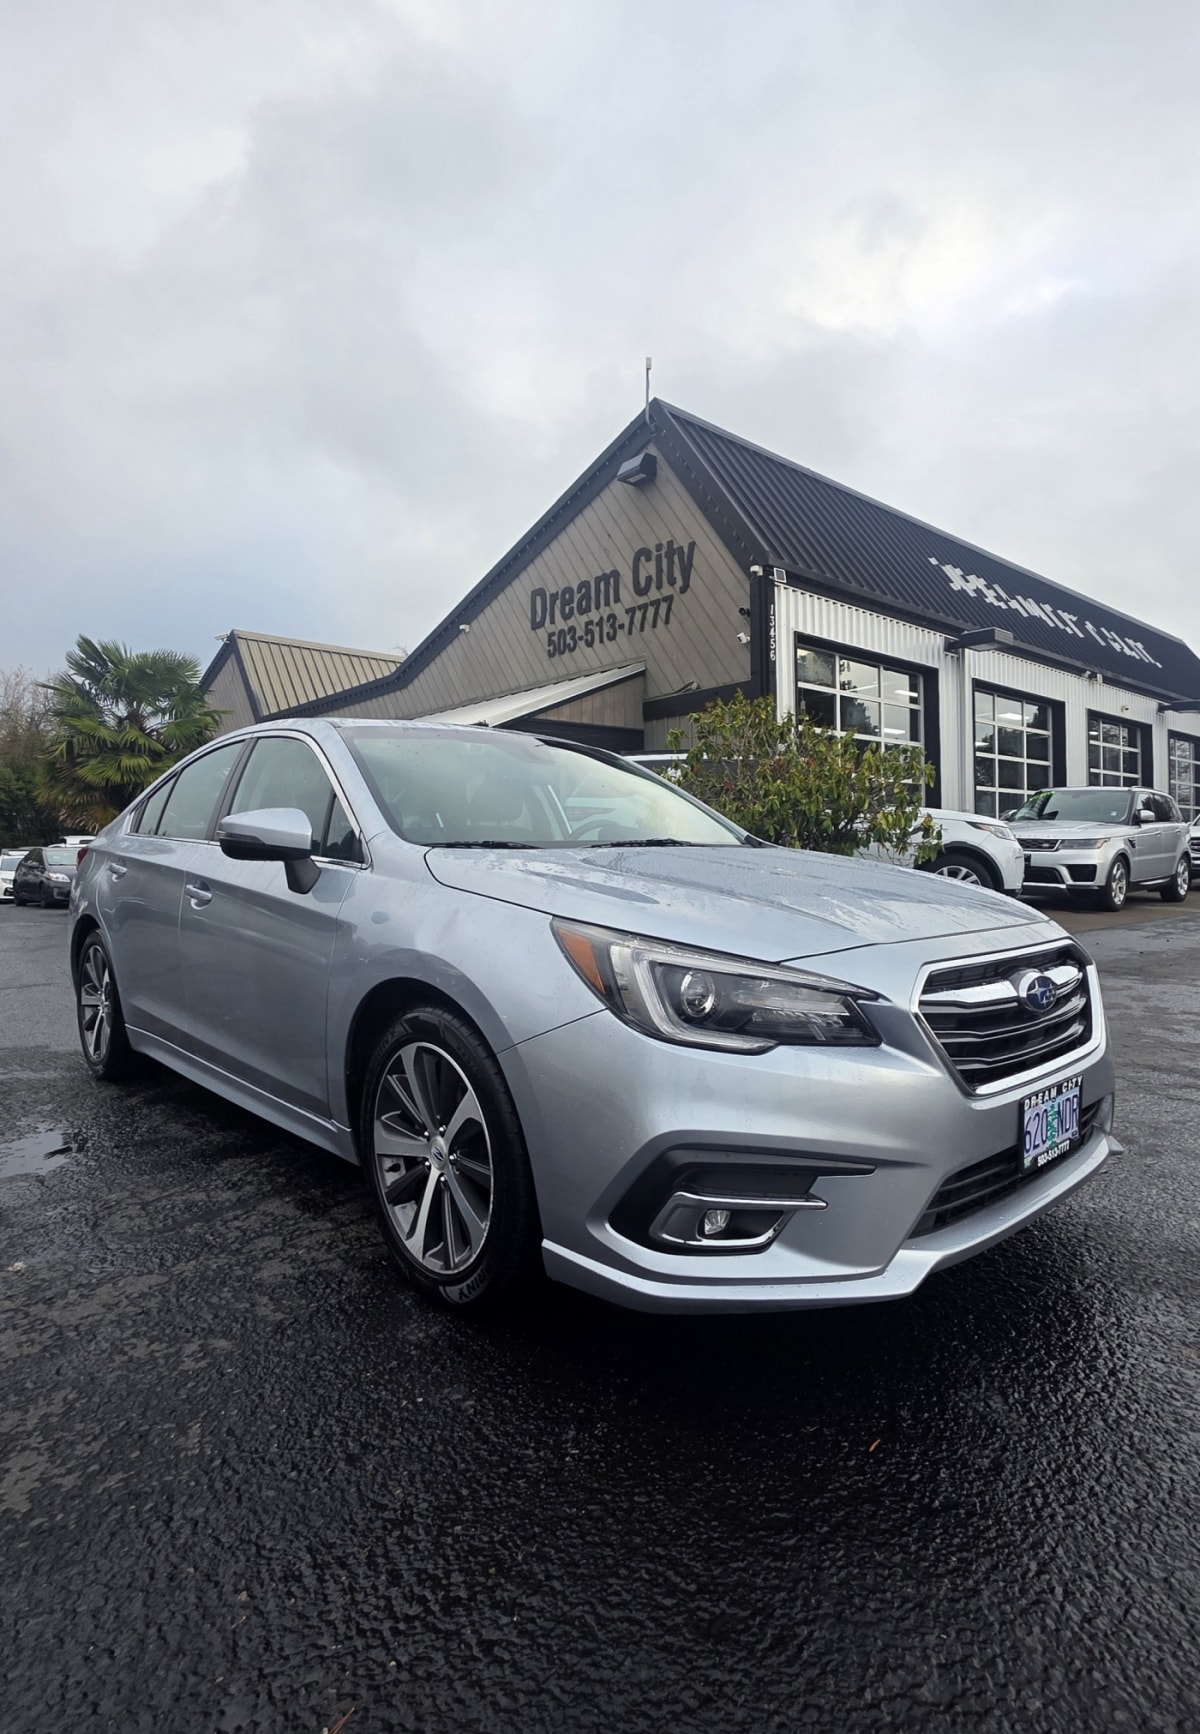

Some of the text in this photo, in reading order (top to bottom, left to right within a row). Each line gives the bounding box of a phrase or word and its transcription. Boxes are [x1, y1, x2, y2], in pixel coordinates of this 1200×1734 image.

[530, 539, 697, 631] Dream City
[547, 594, 675, 659] 503-513-7777
[1024, 1075, 1083, 1111] DREAM CITY
[1024, 1094, 1079, 1154] 620 NDR
[1037, 1140, 1070, 1167] 503-513-7777
